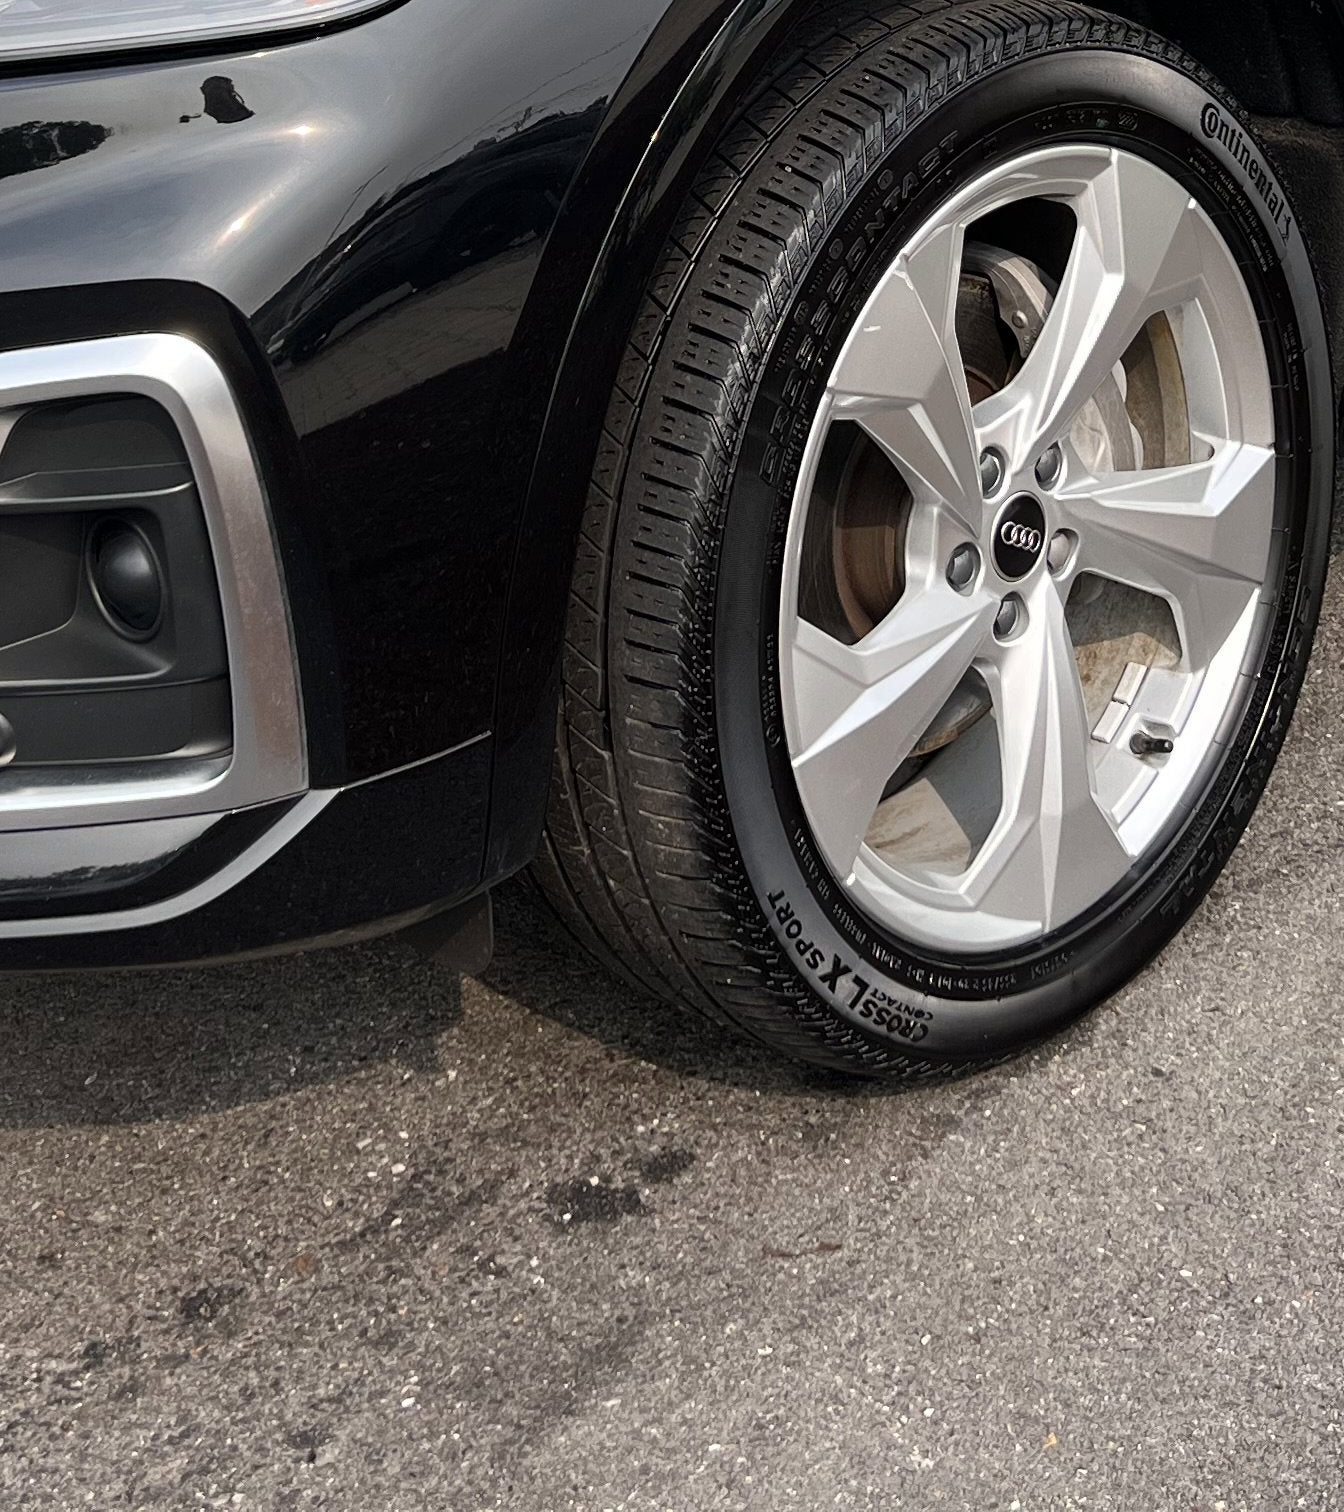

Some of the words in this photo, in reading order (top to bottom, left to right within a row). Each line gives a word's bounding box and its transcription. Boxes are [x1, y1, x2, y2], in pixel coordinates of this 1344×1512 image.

[1200, 102, 1285, 225] Continental
[766, 889, 826, 971] SPORT
[819, 953, 871, 1011] LX
[859, 998, 929, 1043] CROSS
